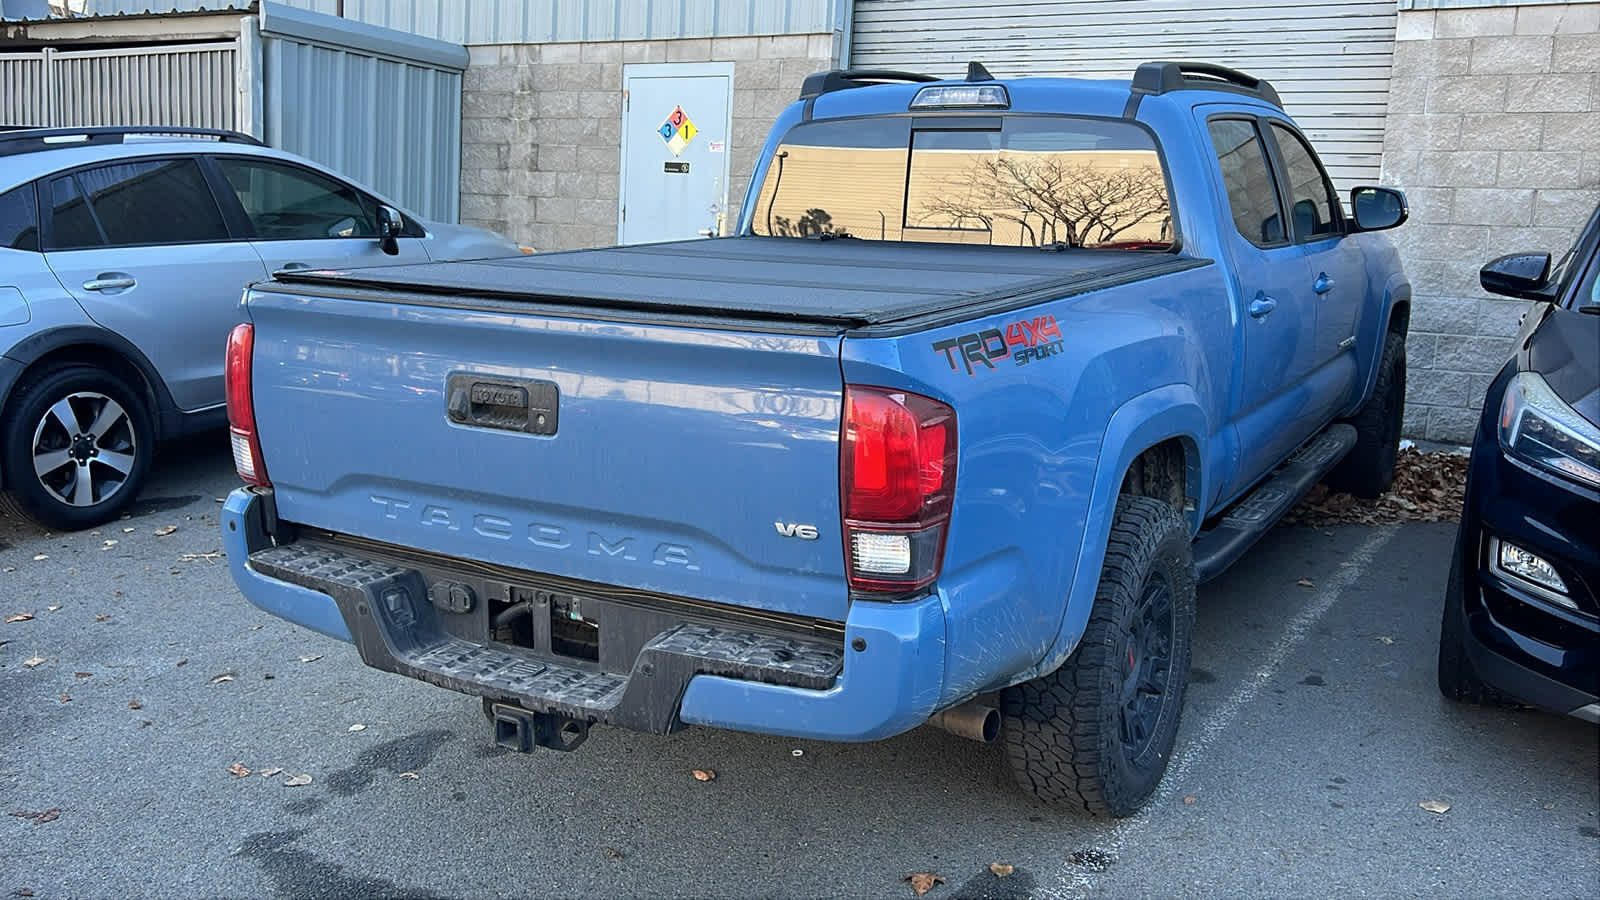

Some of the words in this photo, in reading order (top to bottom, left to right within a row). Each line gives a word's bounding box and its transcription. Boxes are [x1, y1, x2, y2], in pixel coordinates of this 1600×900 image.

[673, 110, 682, 125] 3
[663, 123, 672, 138] 3
[685, 125, 689, 140] 1
[931, 328, 1011, 377] TRD
[1013, 339, 1065, 367] SPORT
[473, 387, 522, 405] TOYOTA
[369, 494, 700, 571] TACOMA
[774, 522, 819, 540] V6
